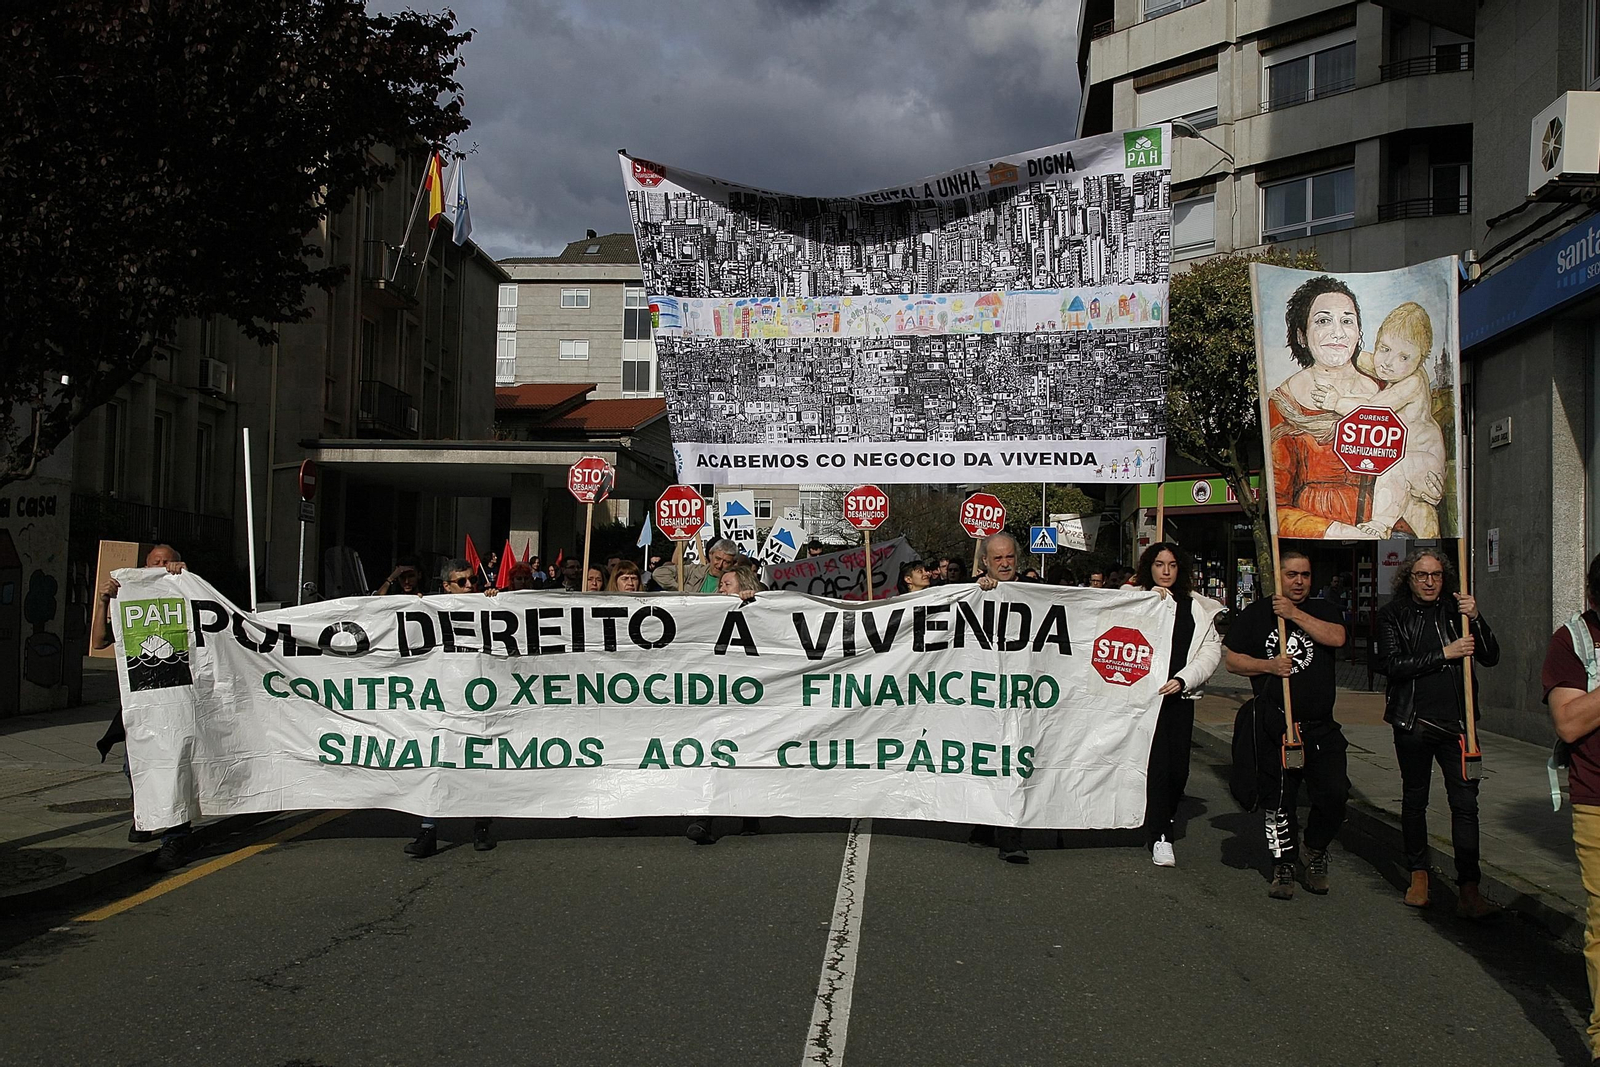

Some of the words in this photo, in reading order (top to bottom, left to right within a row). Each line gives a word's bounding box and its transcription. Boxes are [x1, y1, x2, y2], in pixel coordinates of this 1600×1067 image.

[1127, 152, 1158, 165] PAH
[635, 161, 661, 173] STOP
[924, 182, 934, 198] A
[936, 170, 981, 197] UNHA
[1027, 151, 1076, 177] DIGNA
[1359, 414, 1389, 422] OURENSE
[1342, 422, 1402, 447] STOP
[1341, 444, 1397, 458] DESAFIUZAMENTOS
[696, 453, 809, 469] ACABEMOS
[816, 453, 846, 468] CO
[853, 452, 955, 468] NEGOCIO
[963, 452, 993, 467] DA
[1000, 452, 1098, 467] VIVENDA
[573, 468, 609, 483] STO
[16, 495, 57, 518] casa
[660, 498, 701, 517] STOP
[847, 496, 886, 511] STOP
[965, 502, 1003, 521] STOP
[660, 517, 701, 526] DESAHUCIOS
[723, 518, 738, 529] VI
[963, 517, 1000, 530] DESAHUCIOS
[723, 529, 754, 541] VEN
[770, 538, 782, 553] VI
[125, 603, 182, 628] PAH
[190, 600, 370, 657] POLO
[396, 606, 677, 657] DEREITO
[713, 603, 760, 656] A
[792, 601, 1073, 660] VIVENDA
[1097, 638, 1150, 664] STOP
[1106, 664, 1132, 673] OURENSE
[262, 670, 446, 711] CONTRA
[465, 677, 497, 711] O
[510, 672, 764, 705] XENOCIDIO
[802, 671, 1060, 708] FINANCEIRO
[318, 732, 605, 769] SINALEMOS
[639, 738, 738, 769] AOS
[777, 728, 1035, 779] CULPÁBEIS
